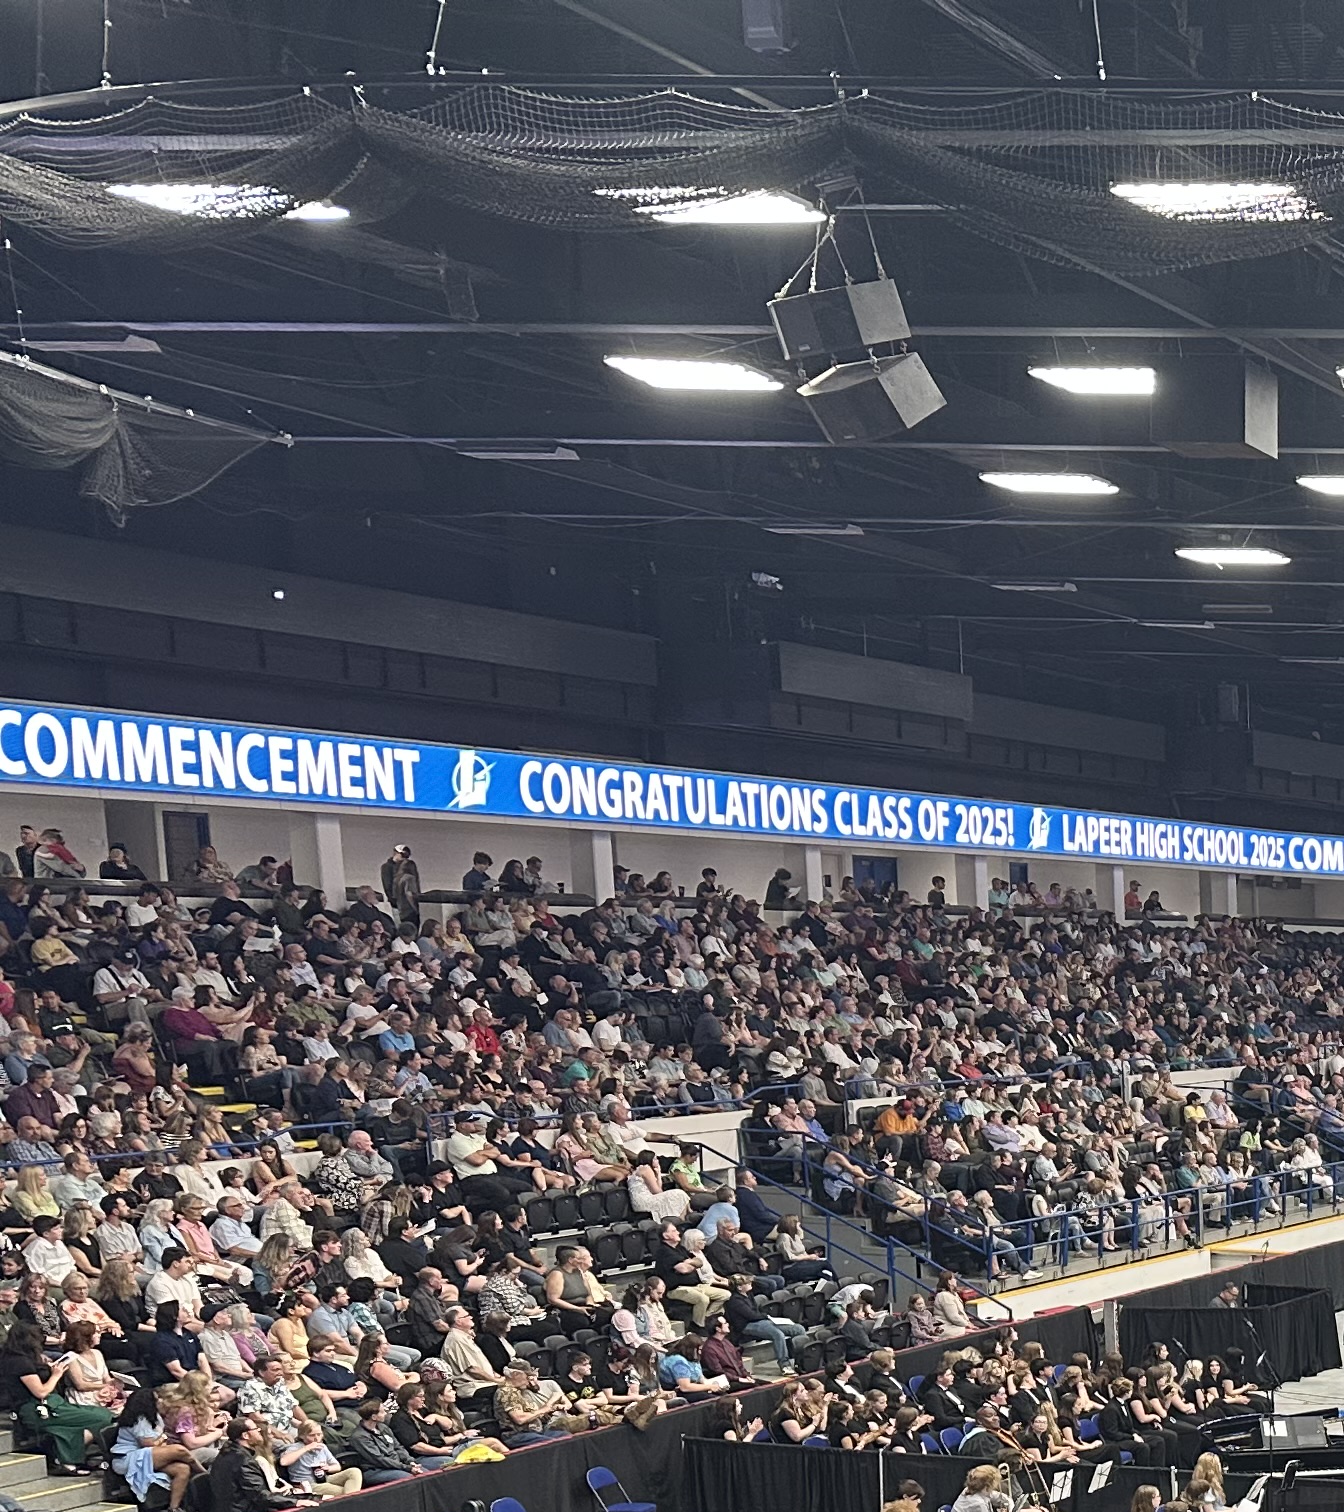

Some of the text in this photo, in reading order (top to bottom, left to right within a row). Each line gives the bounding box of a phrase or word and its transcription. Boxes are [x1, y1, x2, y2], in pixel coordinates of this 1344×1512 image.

[0, 710, 420, 803] COMMENCEMENT
[519, 760, 1014, 847] CONGRATULATIONS CLASS OF 2025!
[1062, 813, 1134, 856] LAPEER
[1135, 821, 1180, 860] HIGH
[1182, 825, 1249, 865] SCHOOL
[1249, 834, 1286, 869] 2025
